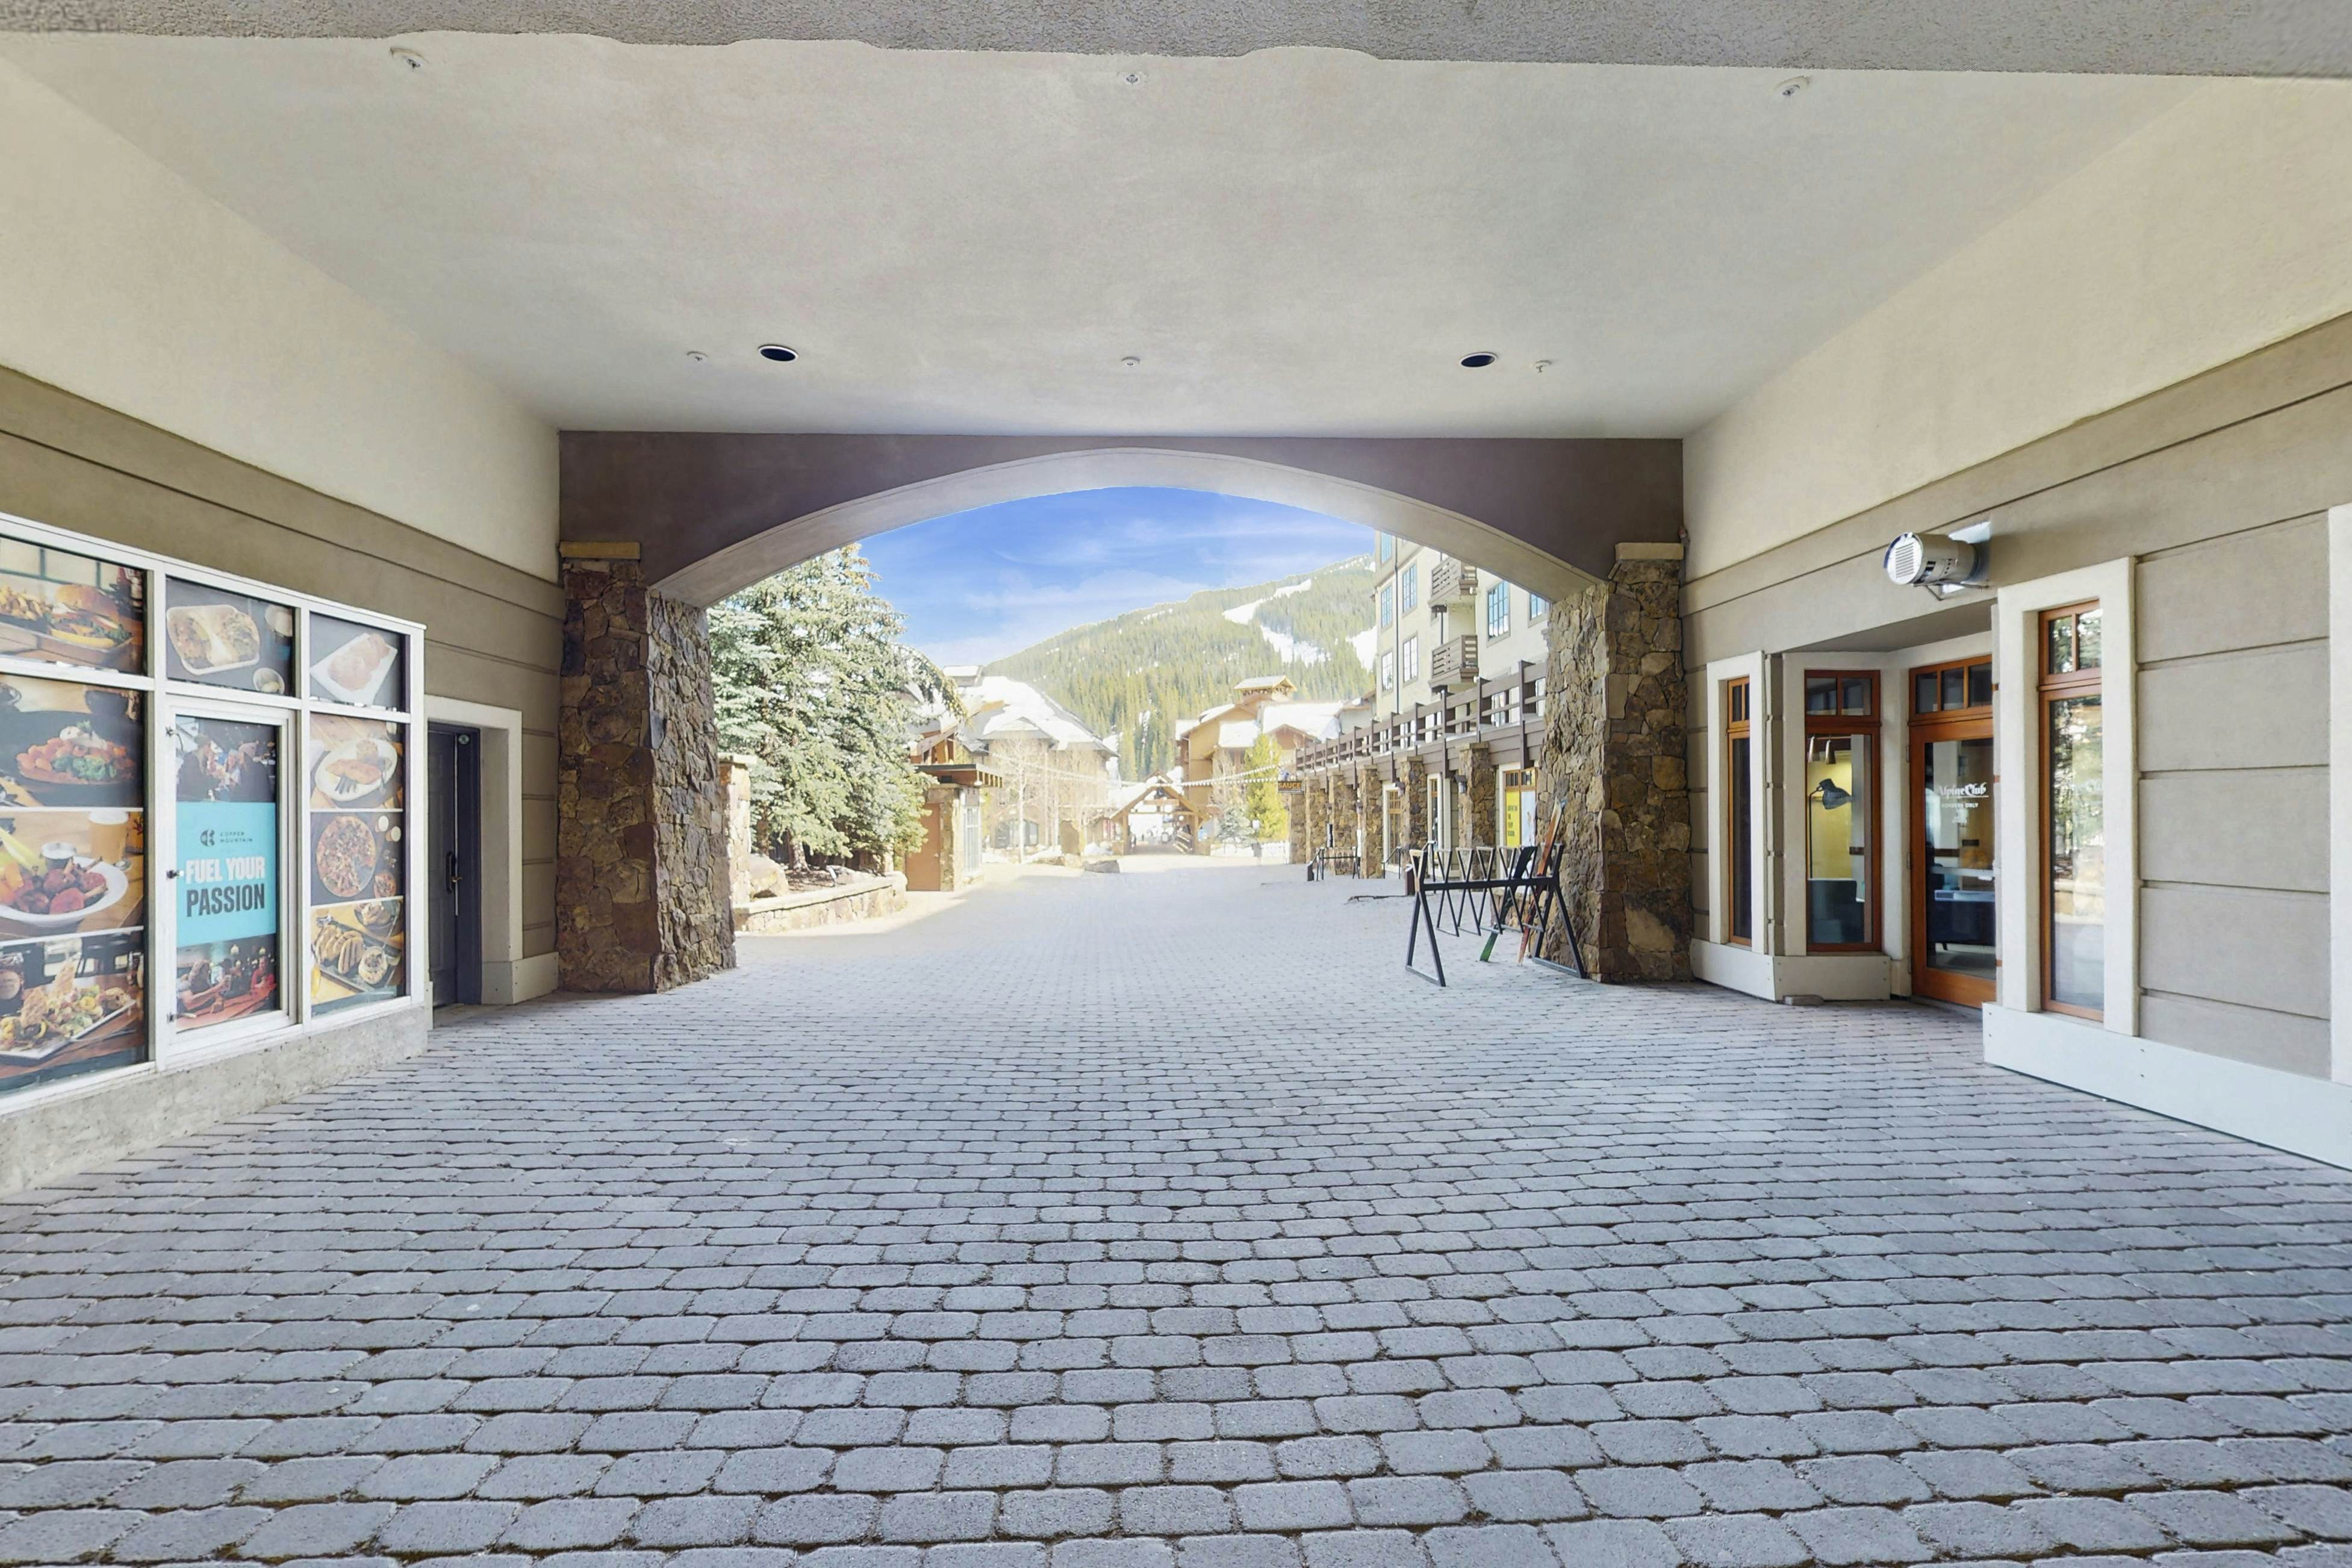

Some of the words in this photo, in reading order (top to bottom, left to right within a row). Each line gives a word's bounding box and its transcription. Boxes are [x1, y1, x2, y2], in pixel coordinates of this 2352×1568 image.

[185, 858, 223, 884] FUEL
[225, 856, 266, 881] YOUR
[186, 883, 264, 917] PASSION
